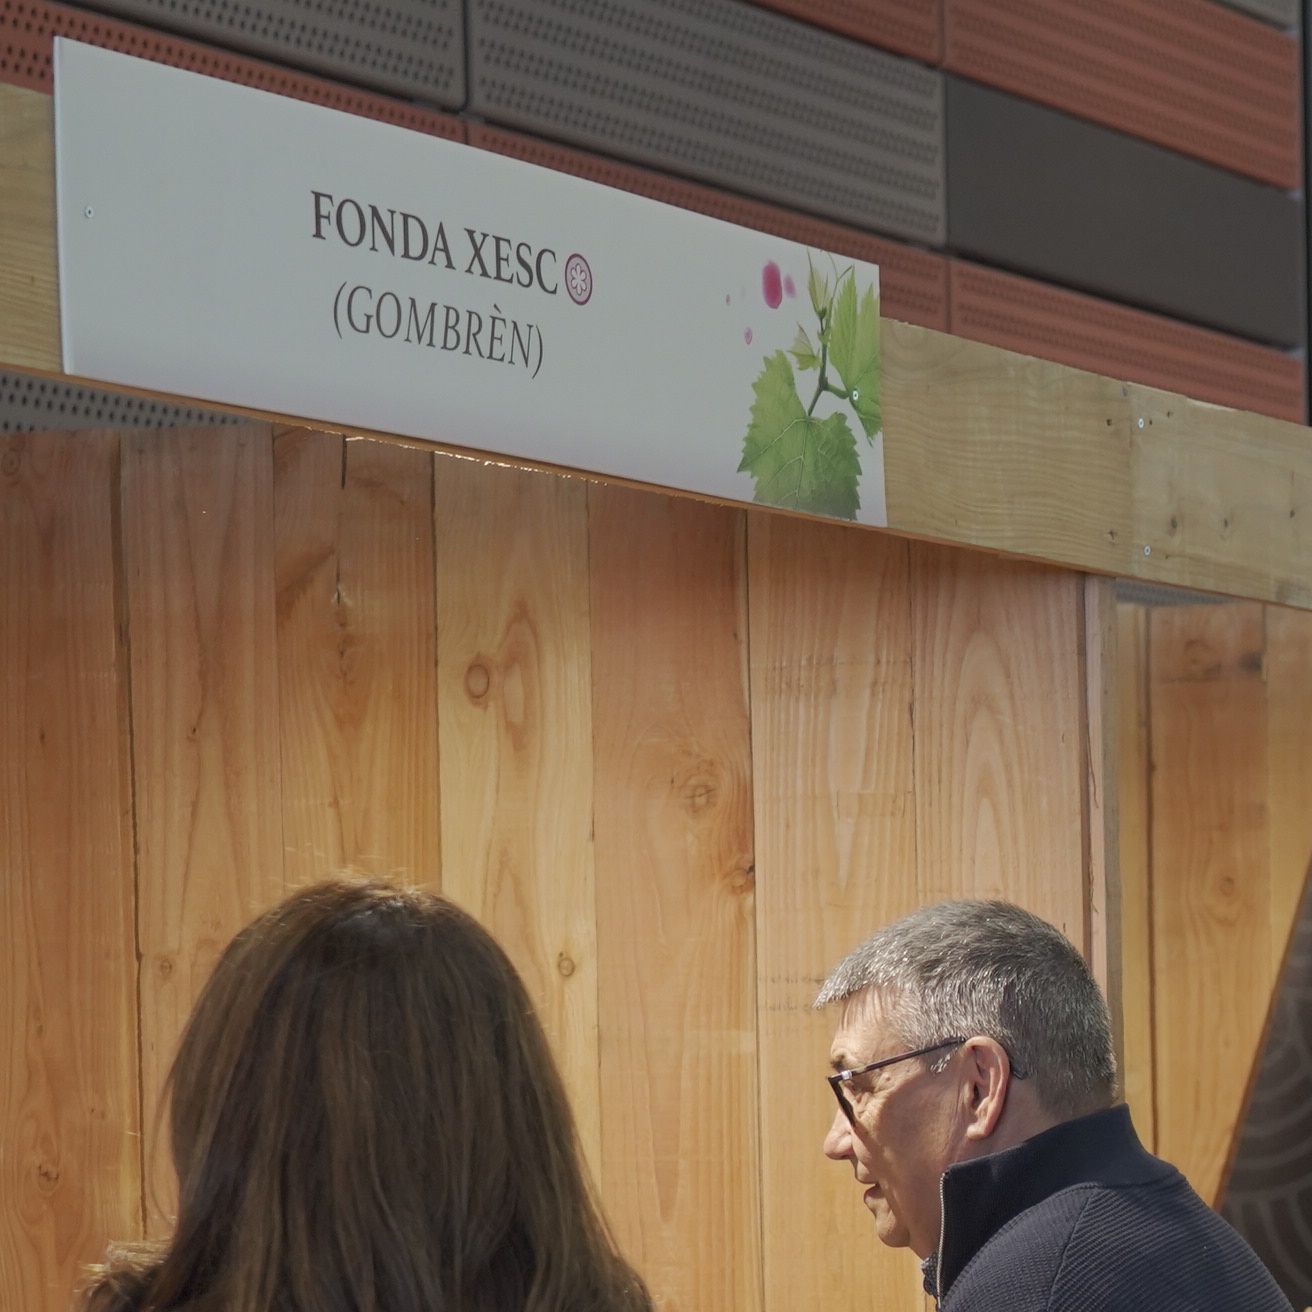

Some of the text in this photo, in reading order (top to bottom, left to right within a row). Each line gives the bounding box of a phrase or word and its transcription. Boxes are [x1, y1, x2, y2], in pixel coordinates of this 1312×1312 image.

[311, 190, 560, 296] FONDA XESC
[333, 281, 546, 379] (GOMBRÈN)
